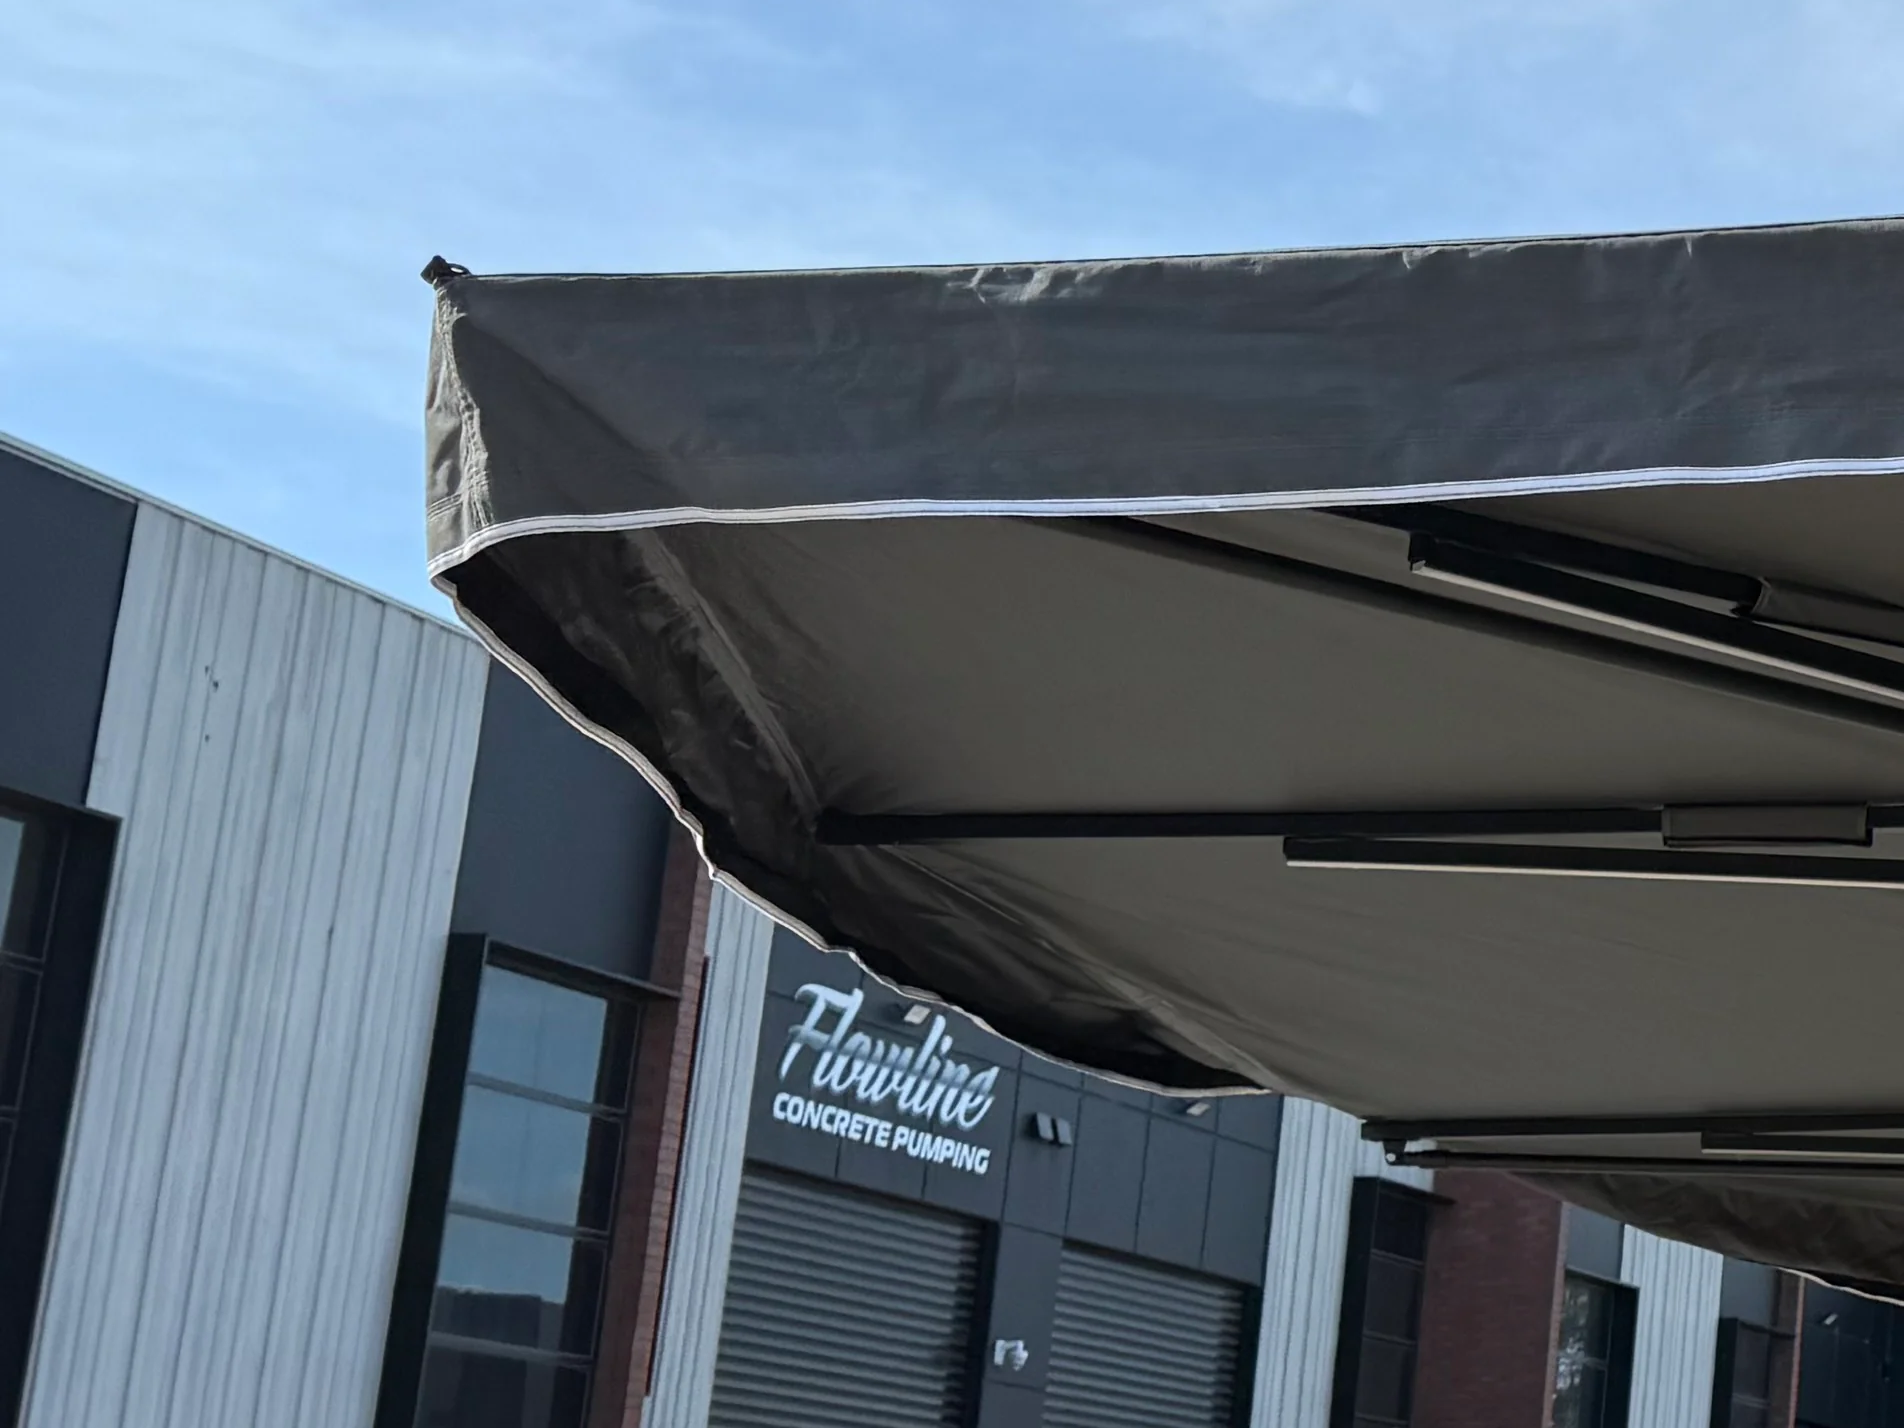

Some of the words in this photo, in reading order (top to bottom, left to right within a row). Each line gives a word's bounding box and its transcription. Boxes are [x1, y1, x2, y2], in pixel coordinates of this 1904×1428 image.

[780, 983, 1001, 1130] Flowline
[773, 1092, 891, 1149] CONCRETE
[891, 1125, 992, 1175] PUMPING
